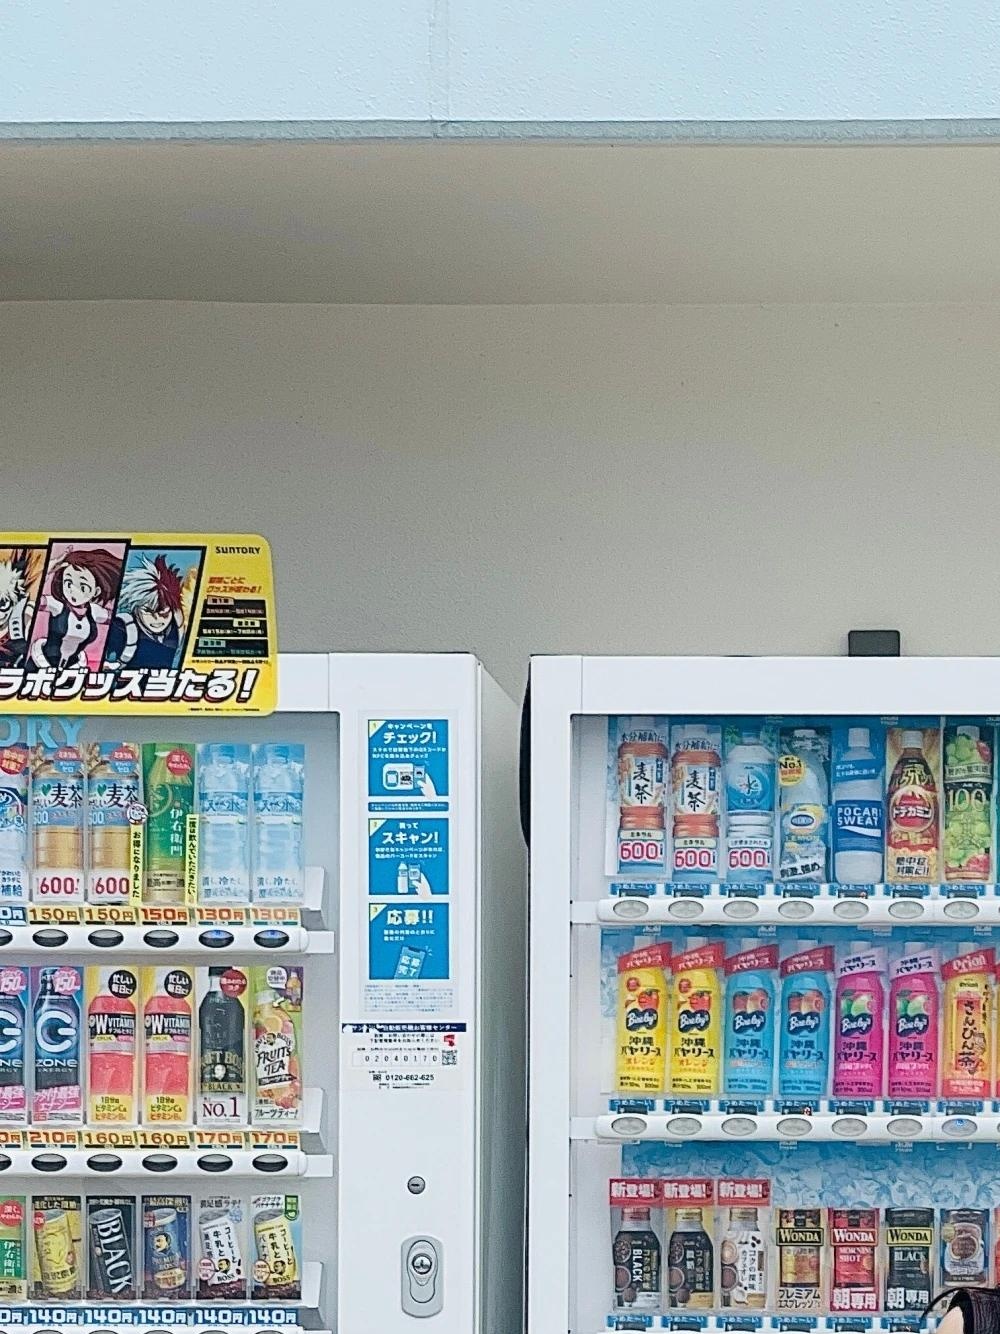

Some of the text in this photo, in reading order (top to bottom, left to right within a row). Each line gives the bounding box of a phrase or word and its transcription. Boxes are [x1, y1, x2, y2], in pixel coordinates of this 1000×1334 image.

[215, 546, 261, 554] SUNTORY
[383, 730, 437, 745] チェック!
[633, 762, 653, 804] 麦茶
[51, 783, 83, 808] 麦茶
[106, 783, 140, 808] 麦茶
[686, 770, 706, 812] 麦茶
[837, 807, 882, 817] POCARI
[837, 815, 879, 826] SWEAT
[382, 831, 439, 845] スキャン!
[620, 842, 658, 860] 600
[674, 850, 712, 868] 600
[728, 850, 766, 868] 600
[40, 876, 75, 895] 600
[95, 877, 130, 895] 600
[30, 908, 78, 920] 150円
[86, 908, 133, 920] 150円
[142, 908, 188, 920] 150円
[197, 908, 244, 920] 130円
[251, 908, 298, 920] 130円
[386, 909, 434, 926] 応募!!
[952, 955, 986, 971] Orion
[628, 1036, 654, 1046] 沖縄
[957, 1000, 977, 1069] さんぴん茶
[681, 1038, 706, 1048] 沖縄
[736, 1039, 761, 1049] 沖縄
[790, 1040, 815, 1050] 沖縄
[842, 1041, 867, 1051] 沖縄
[899, 1041, 924, 1051] 沖縄
[257, 1047, 292, 1068] FRUITS
[621, 1046, 662, 1057] バヤリース
[674, 1047, 715, 1058] バヤリース
[728, 1048, 770, 1059] バヤリース
[783, 1048, 825, 1059] バヤリース
[836, 1051, 877, 1062] バヤリース
[893, 1051, 934, 1062] バヤリース
[263, 1062, 286, 1077] TEA
[202, 1096, 241, 1118] NO.1
[28, 1132, 76, 1143] 210円
[86, 1133, 133, 1145] 160円
[141, 1133, 188, 1145] 160円
[198, 1132, 243, 1144] 170円
[252, 1132, 298, 1144] 170円
[780, 1229, 821, 1243] WONDA
[832, 1228, 875, 1243] WONDA
[889, 1228, 929, 1242] WONDA
[213, 1230, 225, 1257] 牛乳と
[225, 1226, 237, 1264] コーヒーと
[268, 1232, 281, 1259] 牛乳と
[280, 1228, 292, 1266] コーヒーと
[97, 1218, 133, 1294] BLACK
[839, 1254, 862, 1262] SHOT
[894, 1251, 926, 1262] BLACK
[632, 1249, 643, 1283] BLACK
[217, 1273, 235, 1283] BOSS
[272, 1275, 291, 1283] BOSS
[778, 1289, 821, 1299] プレミアム
[833, 1287, 877, 1310] 朝専用
[887, 1286, 930, 1310] 朝専用
[29, 1309, 77, 1323] 140円
[84, 1309, 133, 1323] 140円
[138, 1309, 187, 1323] 140円
[195, 1309, 243, 1323] 140円
[249, 1309, 297, 1323] 140円
